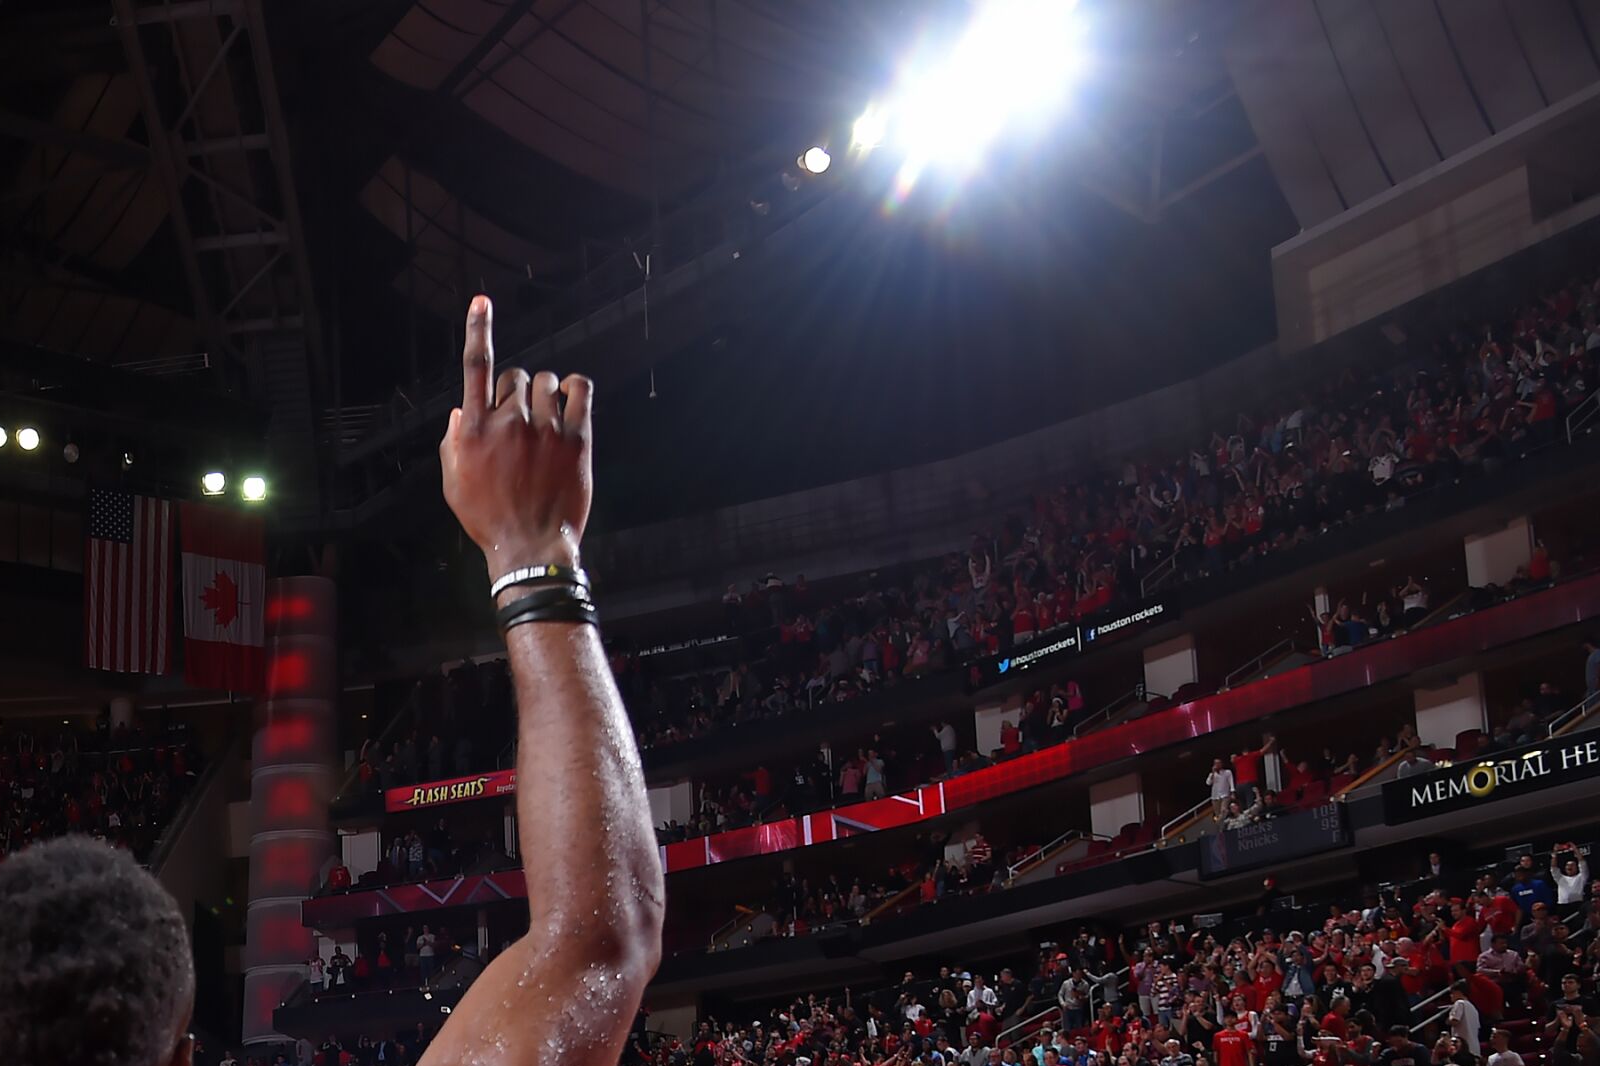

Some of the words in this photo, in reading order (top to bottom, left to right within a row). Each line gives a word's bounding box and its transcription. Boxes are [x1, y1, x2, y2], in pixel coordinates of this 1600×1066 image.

[1097, 616, 1131, 635] houston
[1131, 603, 1164, 623] rockets
[408, 786, 448, 806] FLASH
[450, 777, 490, 799] SEATS
[1411, 750, 1551, 807] MEMORIAL
